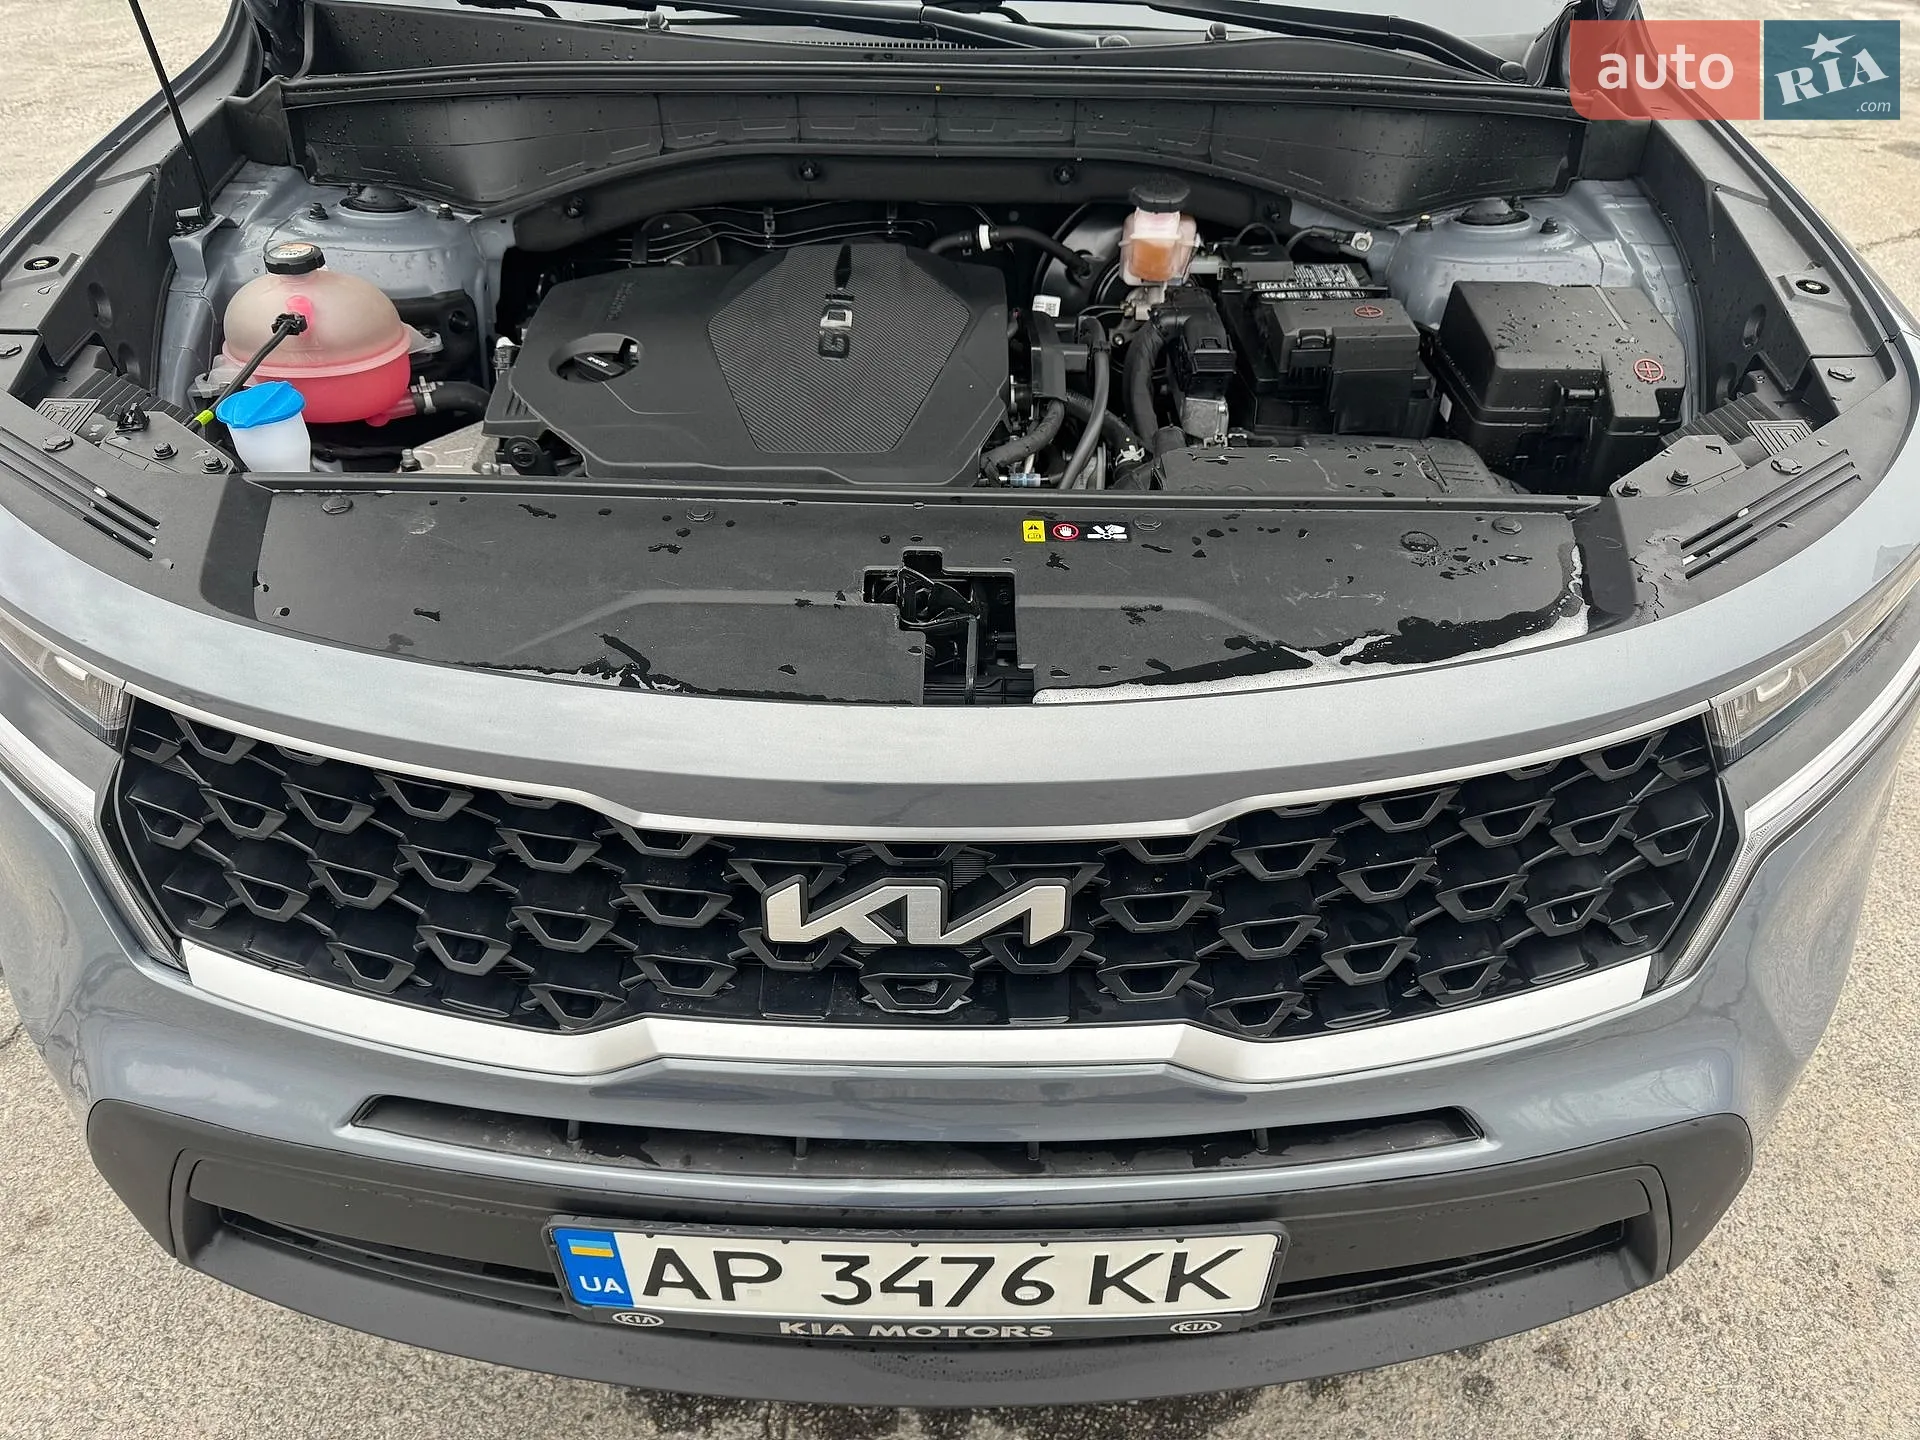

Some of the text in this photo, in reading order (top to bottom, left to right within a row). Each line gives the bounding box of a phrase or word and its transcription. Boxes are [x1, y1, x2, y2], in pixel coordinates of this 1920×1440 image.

[766, 883, 1067, 945] KIA
[578, 1275, 625, 1294] UA
[642, 1247, 1244, 1308] AP 3476 KK
[618, 1313, 658, 1325] KIA
[1177, 1321, 1216, 1332] KIA
[778, 1321, 1054, 1338] KIA MOTORS
